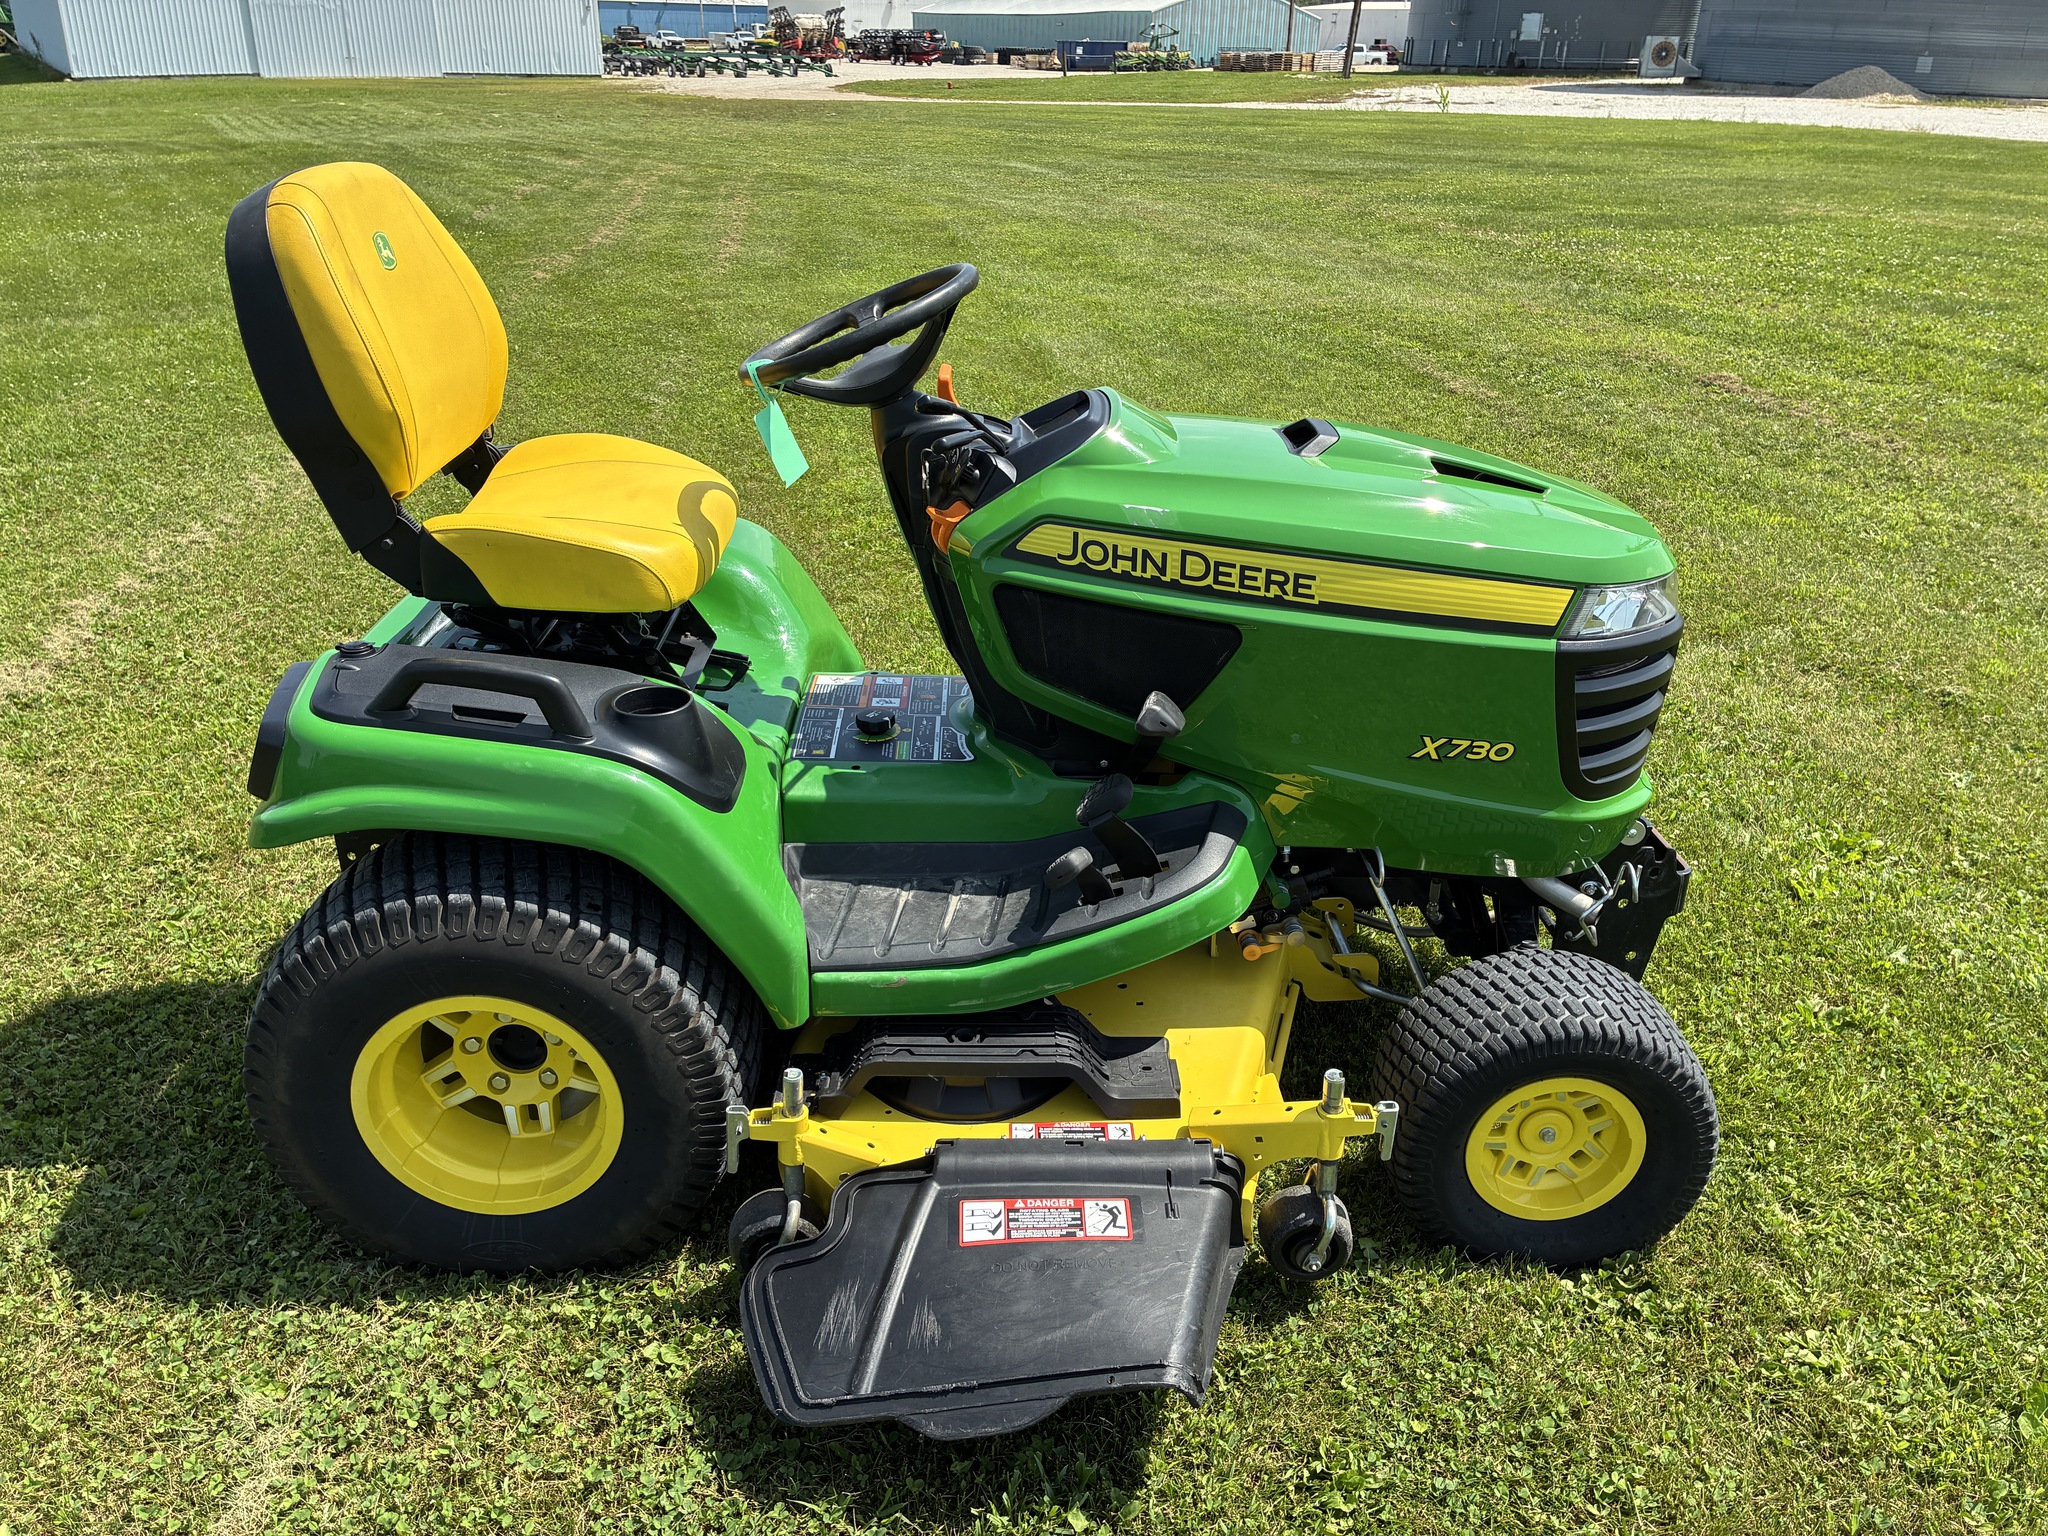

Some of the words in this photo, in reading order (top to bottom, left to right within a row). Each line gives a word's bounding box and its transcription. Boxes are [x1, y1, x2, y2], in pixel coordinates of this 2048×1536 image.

[1055, 529, 1169, 579] JOHN
[1180, 548, 1319, 603] DEERE
[1410, 735, 1516, 762] X730
[1027, 1199, 1074, 1207] DANGER
